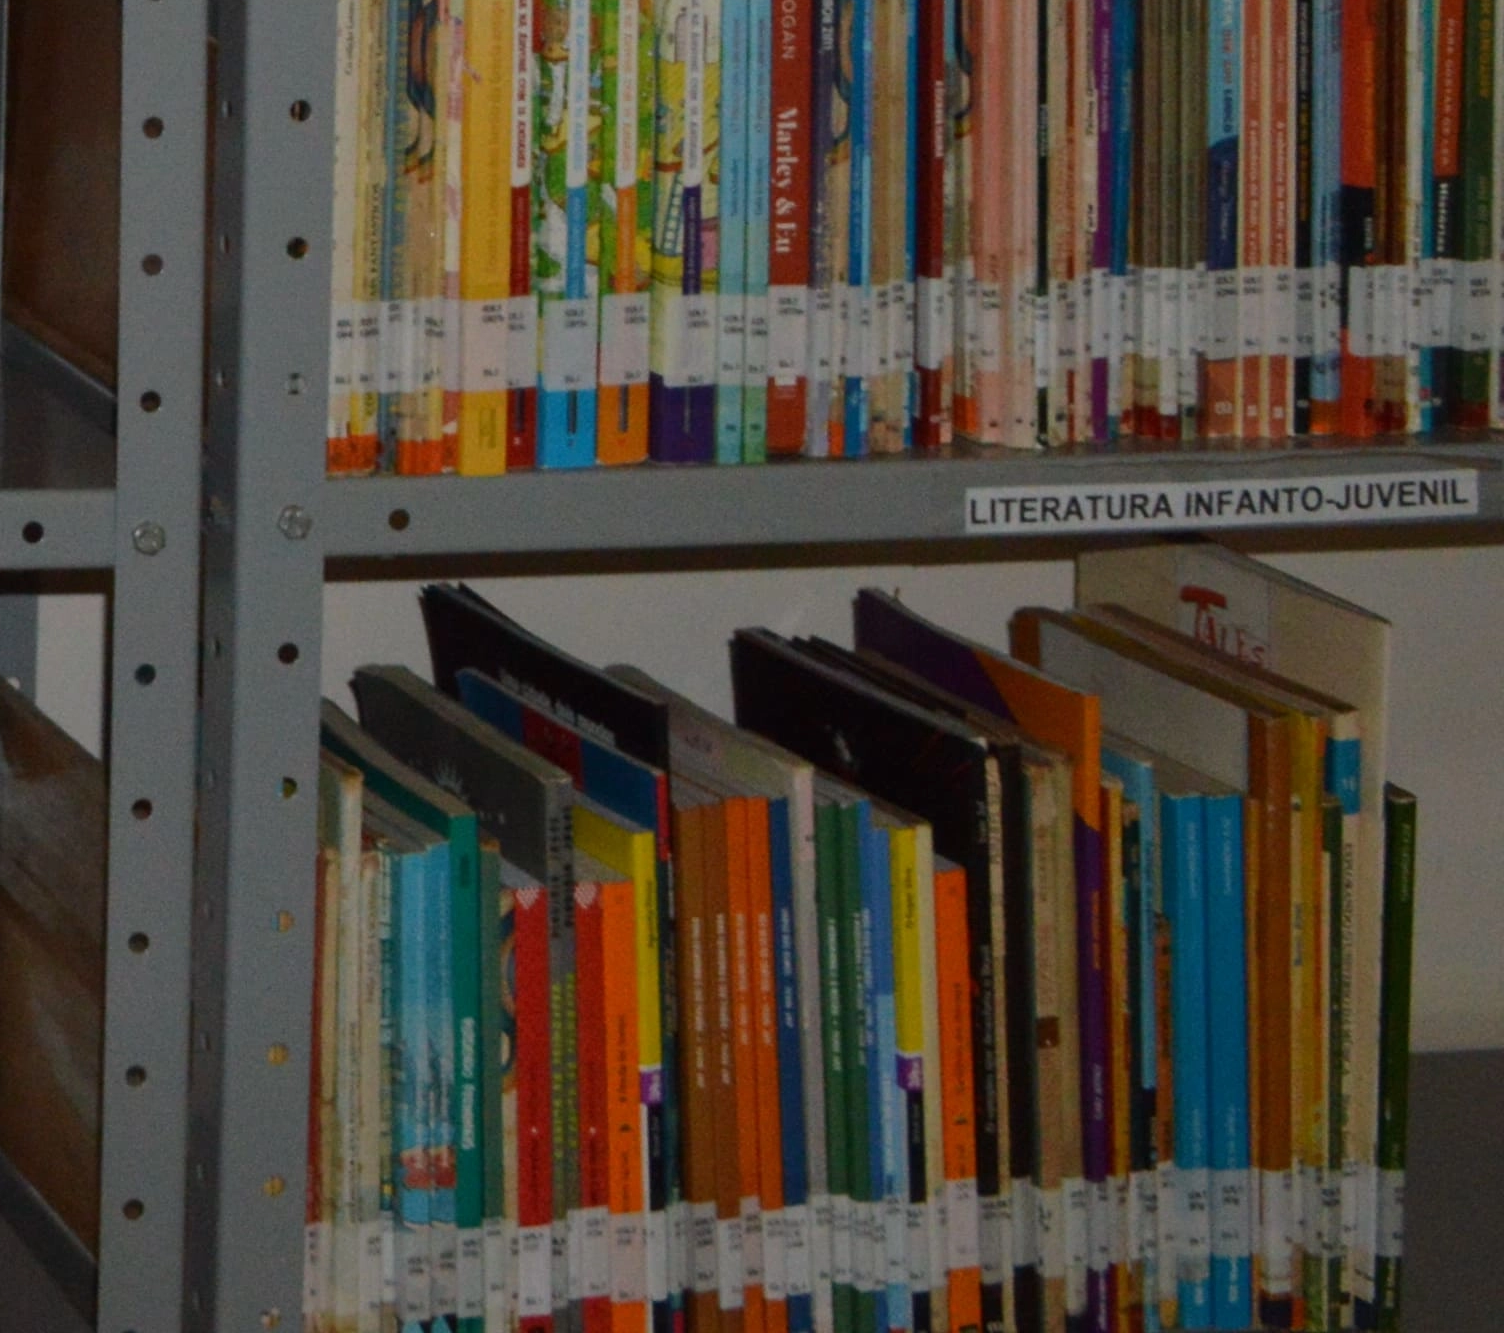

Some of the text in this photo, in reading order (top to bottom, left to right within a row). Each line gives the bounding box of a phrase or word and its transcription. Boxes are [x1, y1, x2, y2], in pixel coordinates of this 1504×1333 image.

[770, 107, 798, 254] Marley & Eu
[1436, 183, 1449, 254] Histórias
[970, 478, 1469, 524] LITERATURA INFANTO-JUVENIL
